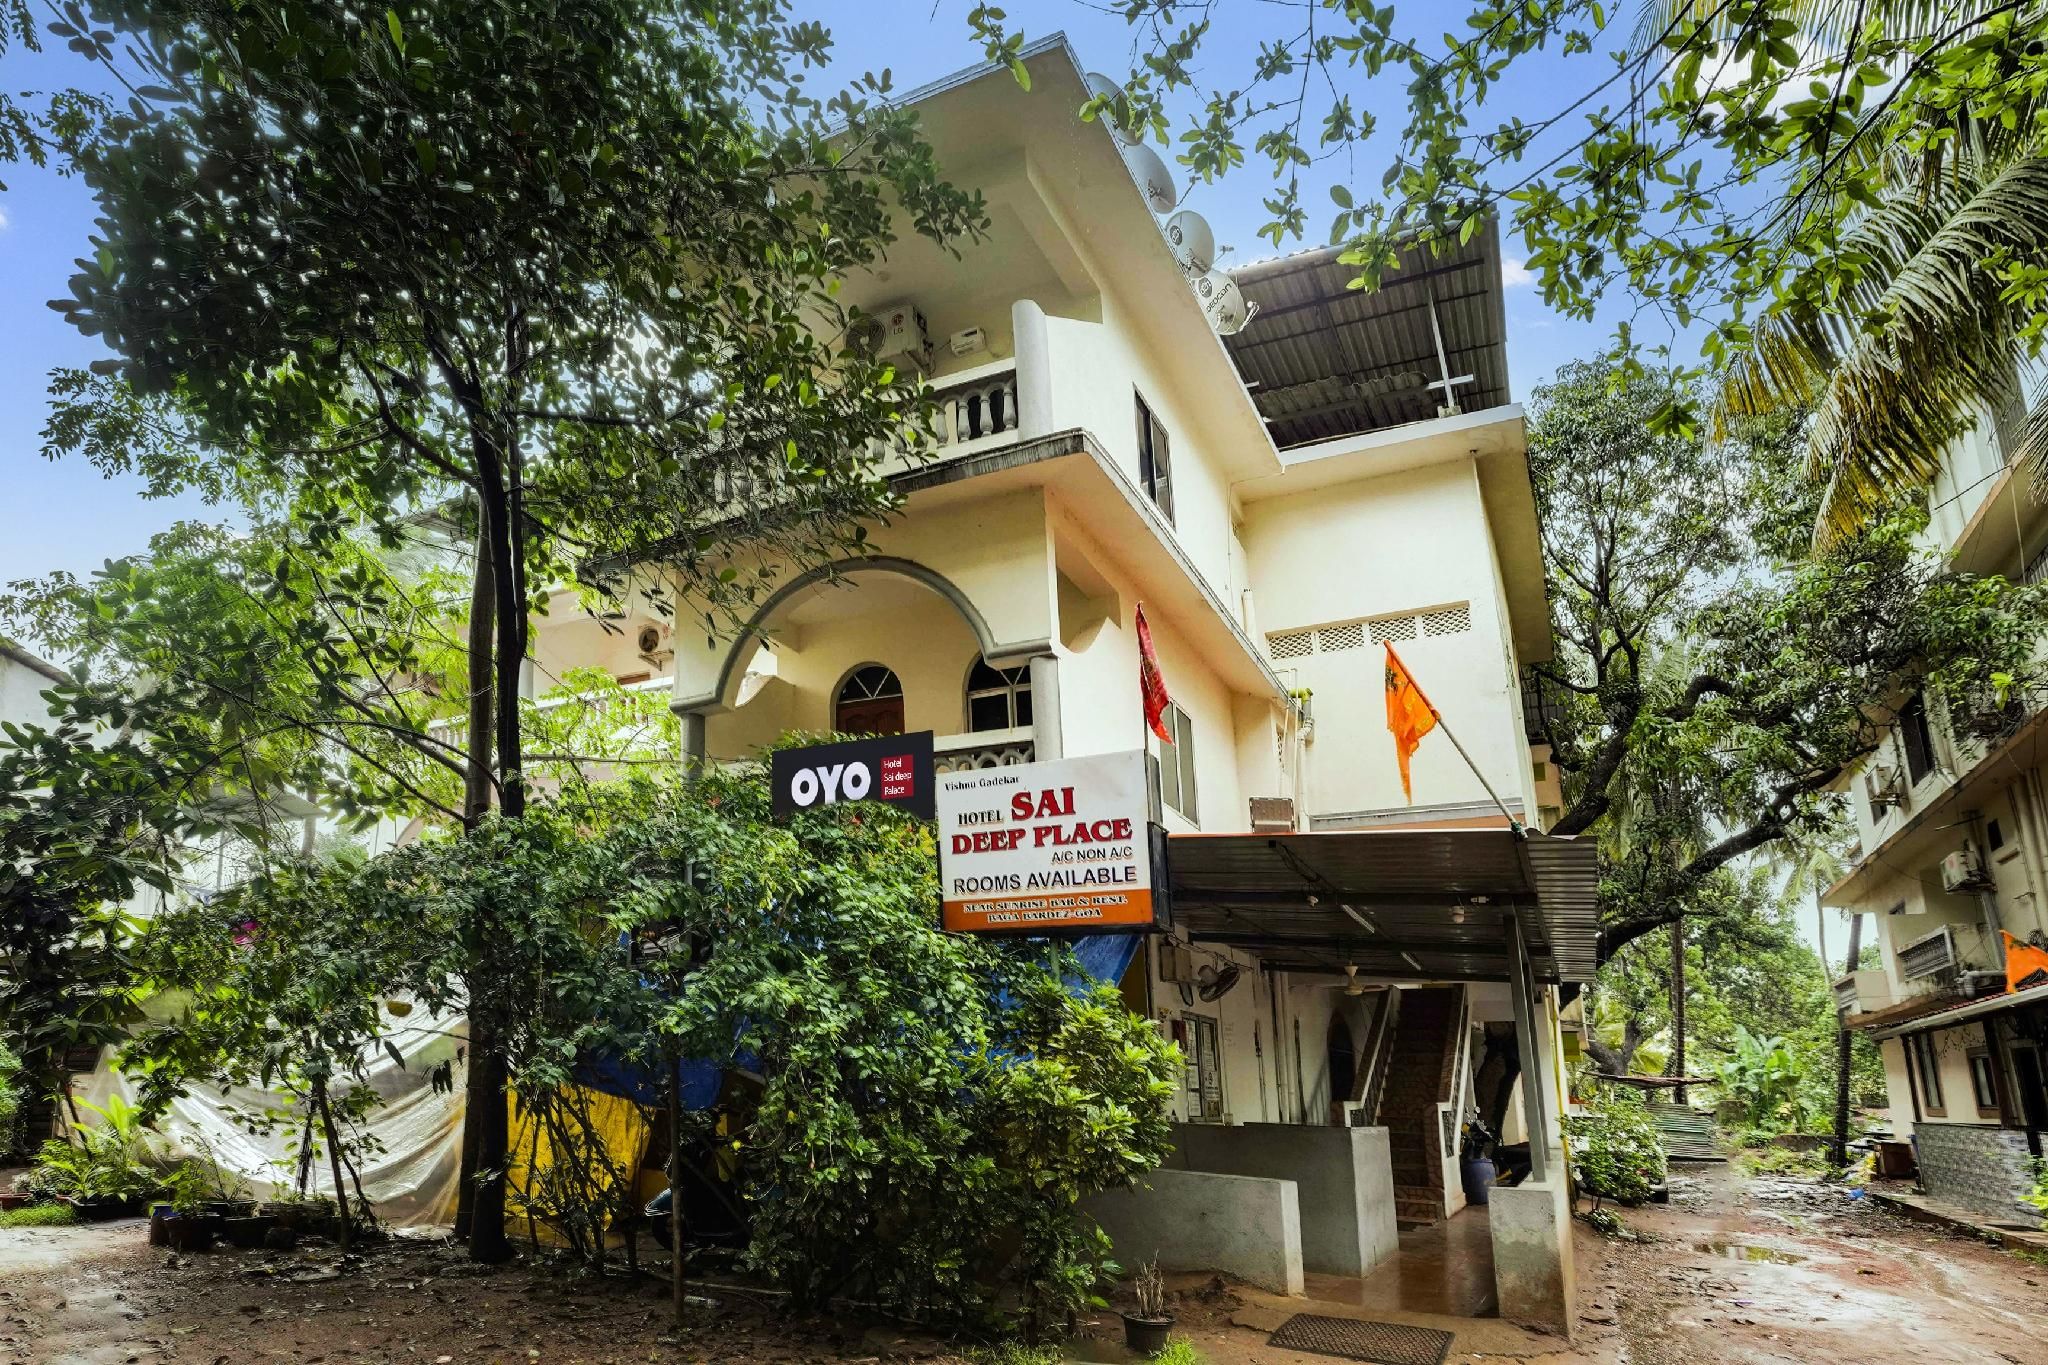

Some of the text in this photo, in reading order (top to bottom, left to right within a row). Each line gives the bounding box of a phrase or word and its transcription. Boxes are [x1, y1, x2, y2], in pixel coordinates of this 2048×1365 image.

[883, 757, 902, 769] Hotel
[791, 761, 871, 806] OYO
[883, 771, 912, 782] Sai deep
[945, 775, 1020, 791] Vishnu Gadekar
[884, 785, 905, 796] Palace
[958, 786, 1076, 825] HOTEL SAI
[952, 818, 1133, 854] DEEP PLACE
[1051, 846, 1133, 863] A/C NON A/C
[953, 866, 1137, 894] ROOMS AVAILABLE
[964, 902, 994, 912] NEAR
[996, 900, 1047, 911] SUNRISE
[1050, 898, 1075, 909] BAR
[1078, 896, 1089, 907] &
[988, 912, 1020, 923] BAGA
